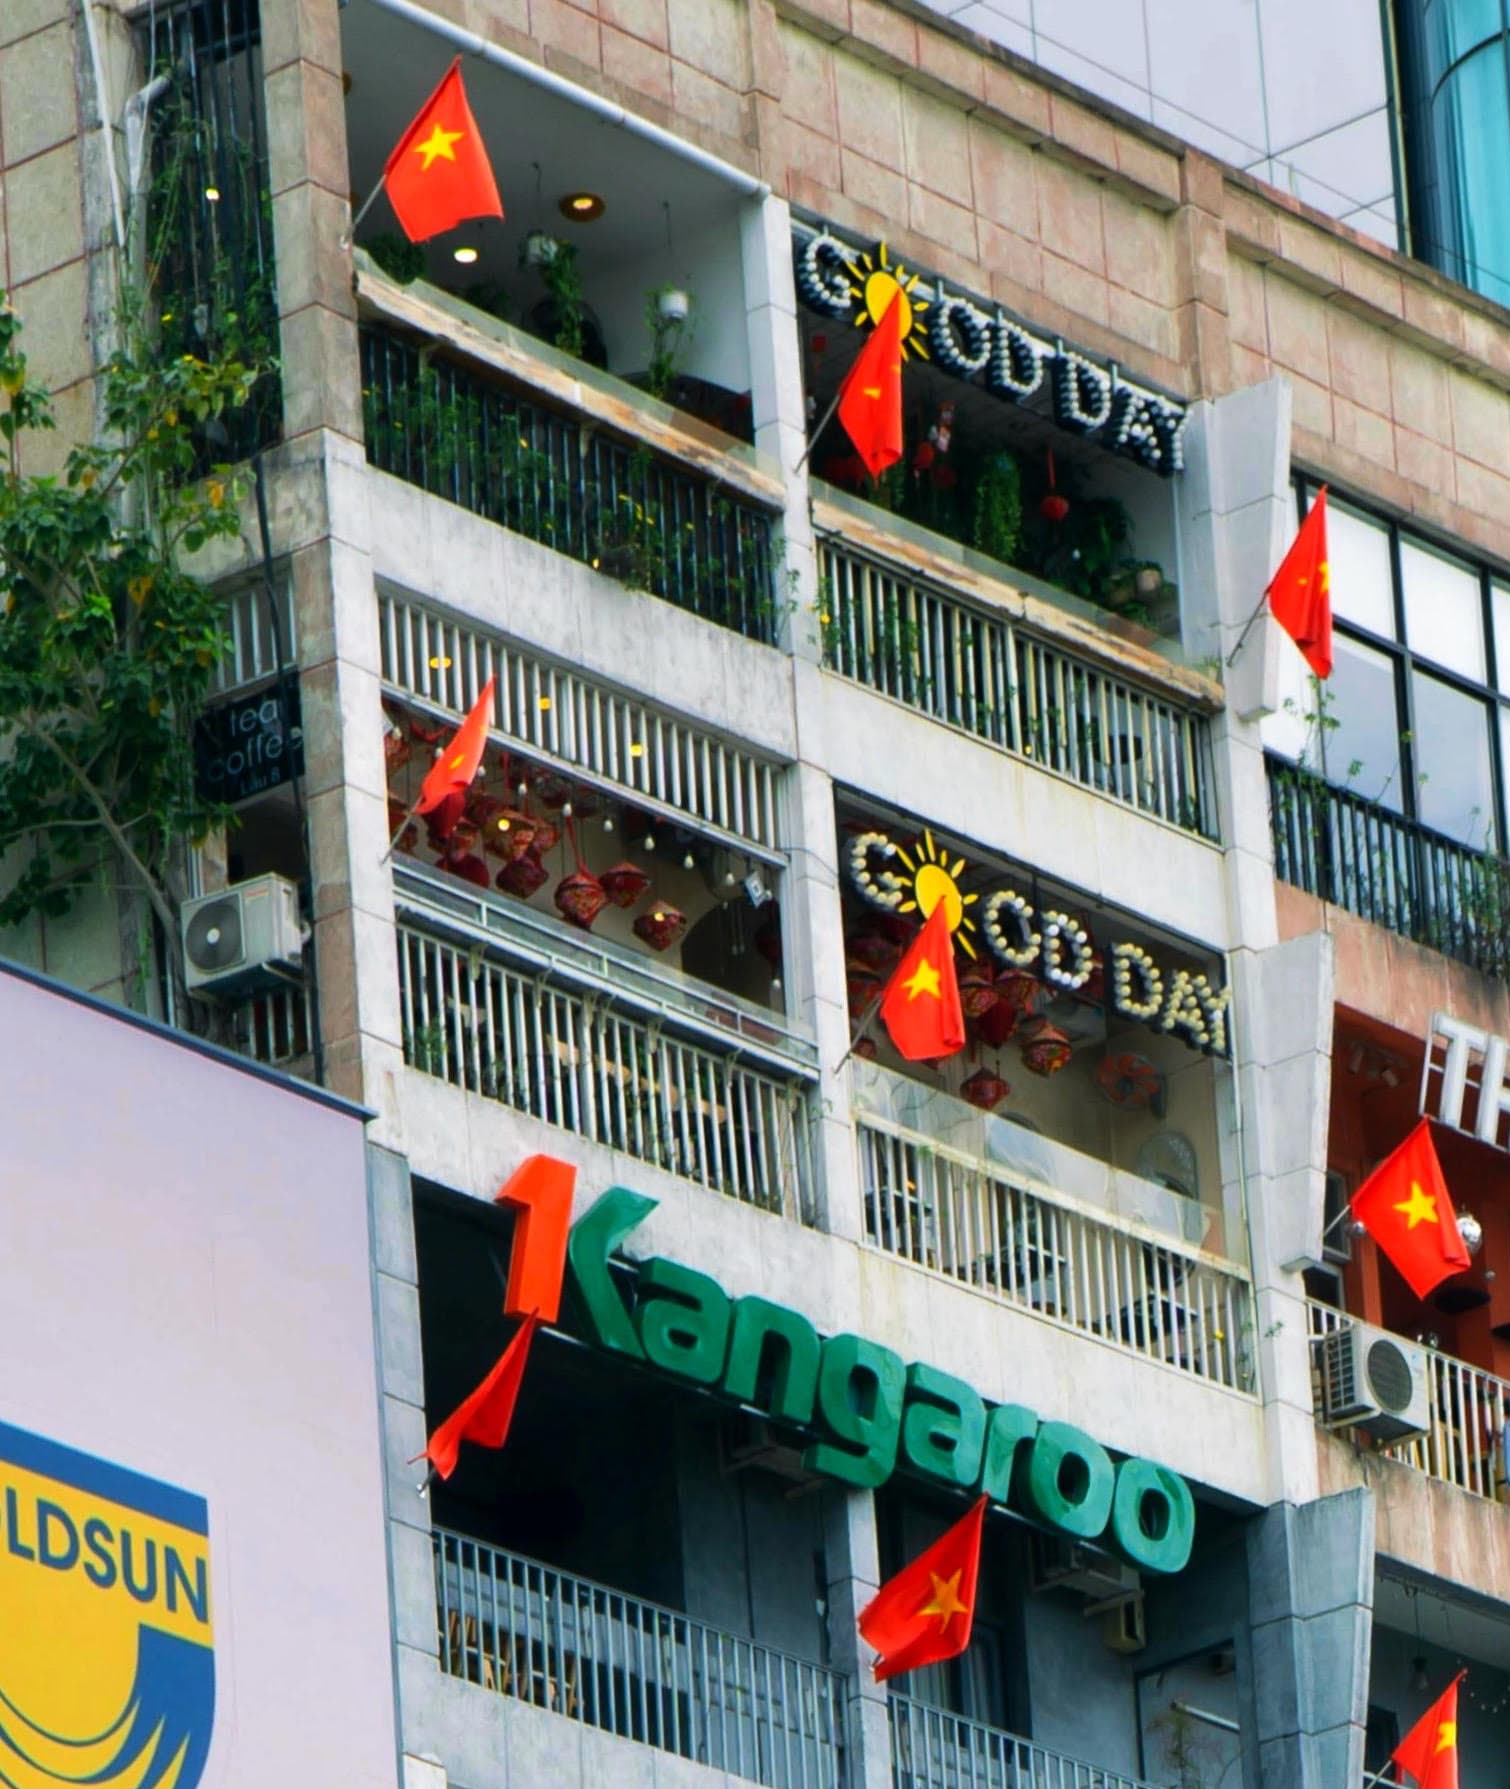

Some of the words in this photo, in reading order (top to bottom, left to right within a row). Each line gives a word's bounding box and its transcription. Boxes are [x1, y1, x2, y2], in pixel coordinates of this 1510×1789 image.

[1054, 350, 1193, 474] DAY
[231, 699, 279, 736] tea
[1111, 941, 1233, 1056] DAY
[570, 1186, 1196, 1576] Kangaroo
[0, 1485, 210, 1625] LDSUN
